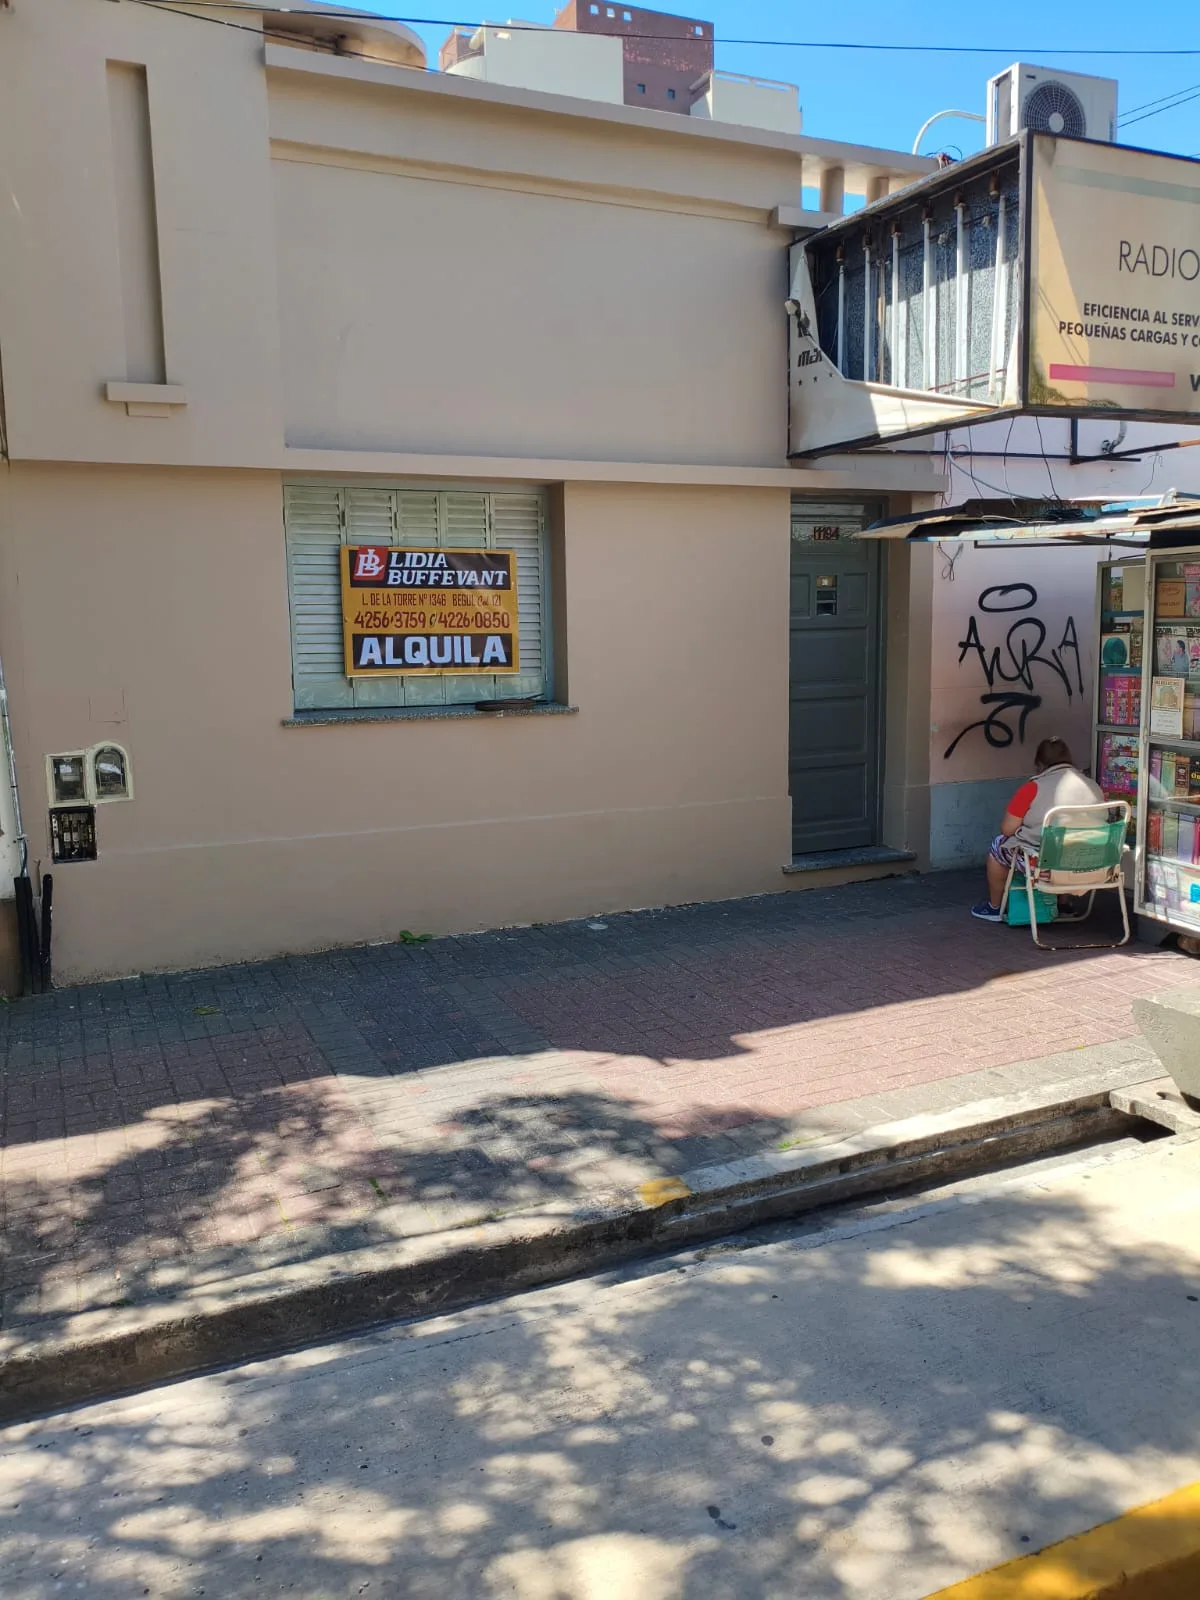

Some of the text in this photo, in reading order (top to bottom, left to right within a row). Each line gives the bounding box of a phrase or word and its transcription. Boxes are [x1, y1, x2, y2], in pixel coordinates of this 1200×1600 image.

[1119, 240, 1200, 281] RADIO
[1083, 302, 1150, 323] EFICIENCIA
[1153, 310, 1168, 325] AL
[1058, 320, 1200, 348] PEQUEÑAS CARGAS Y C
[389, 552, 448, 568] LIDIA
[387, 569, 508, 586] BUFFEVANT
[370, 593, 380, 606] DE
[382, 593, 392, 606] LA
[393, 593, 417, 606] TORRE
[429, 594, 447, 606] 1346
[359, 635, 508, 666] ALQUILA
